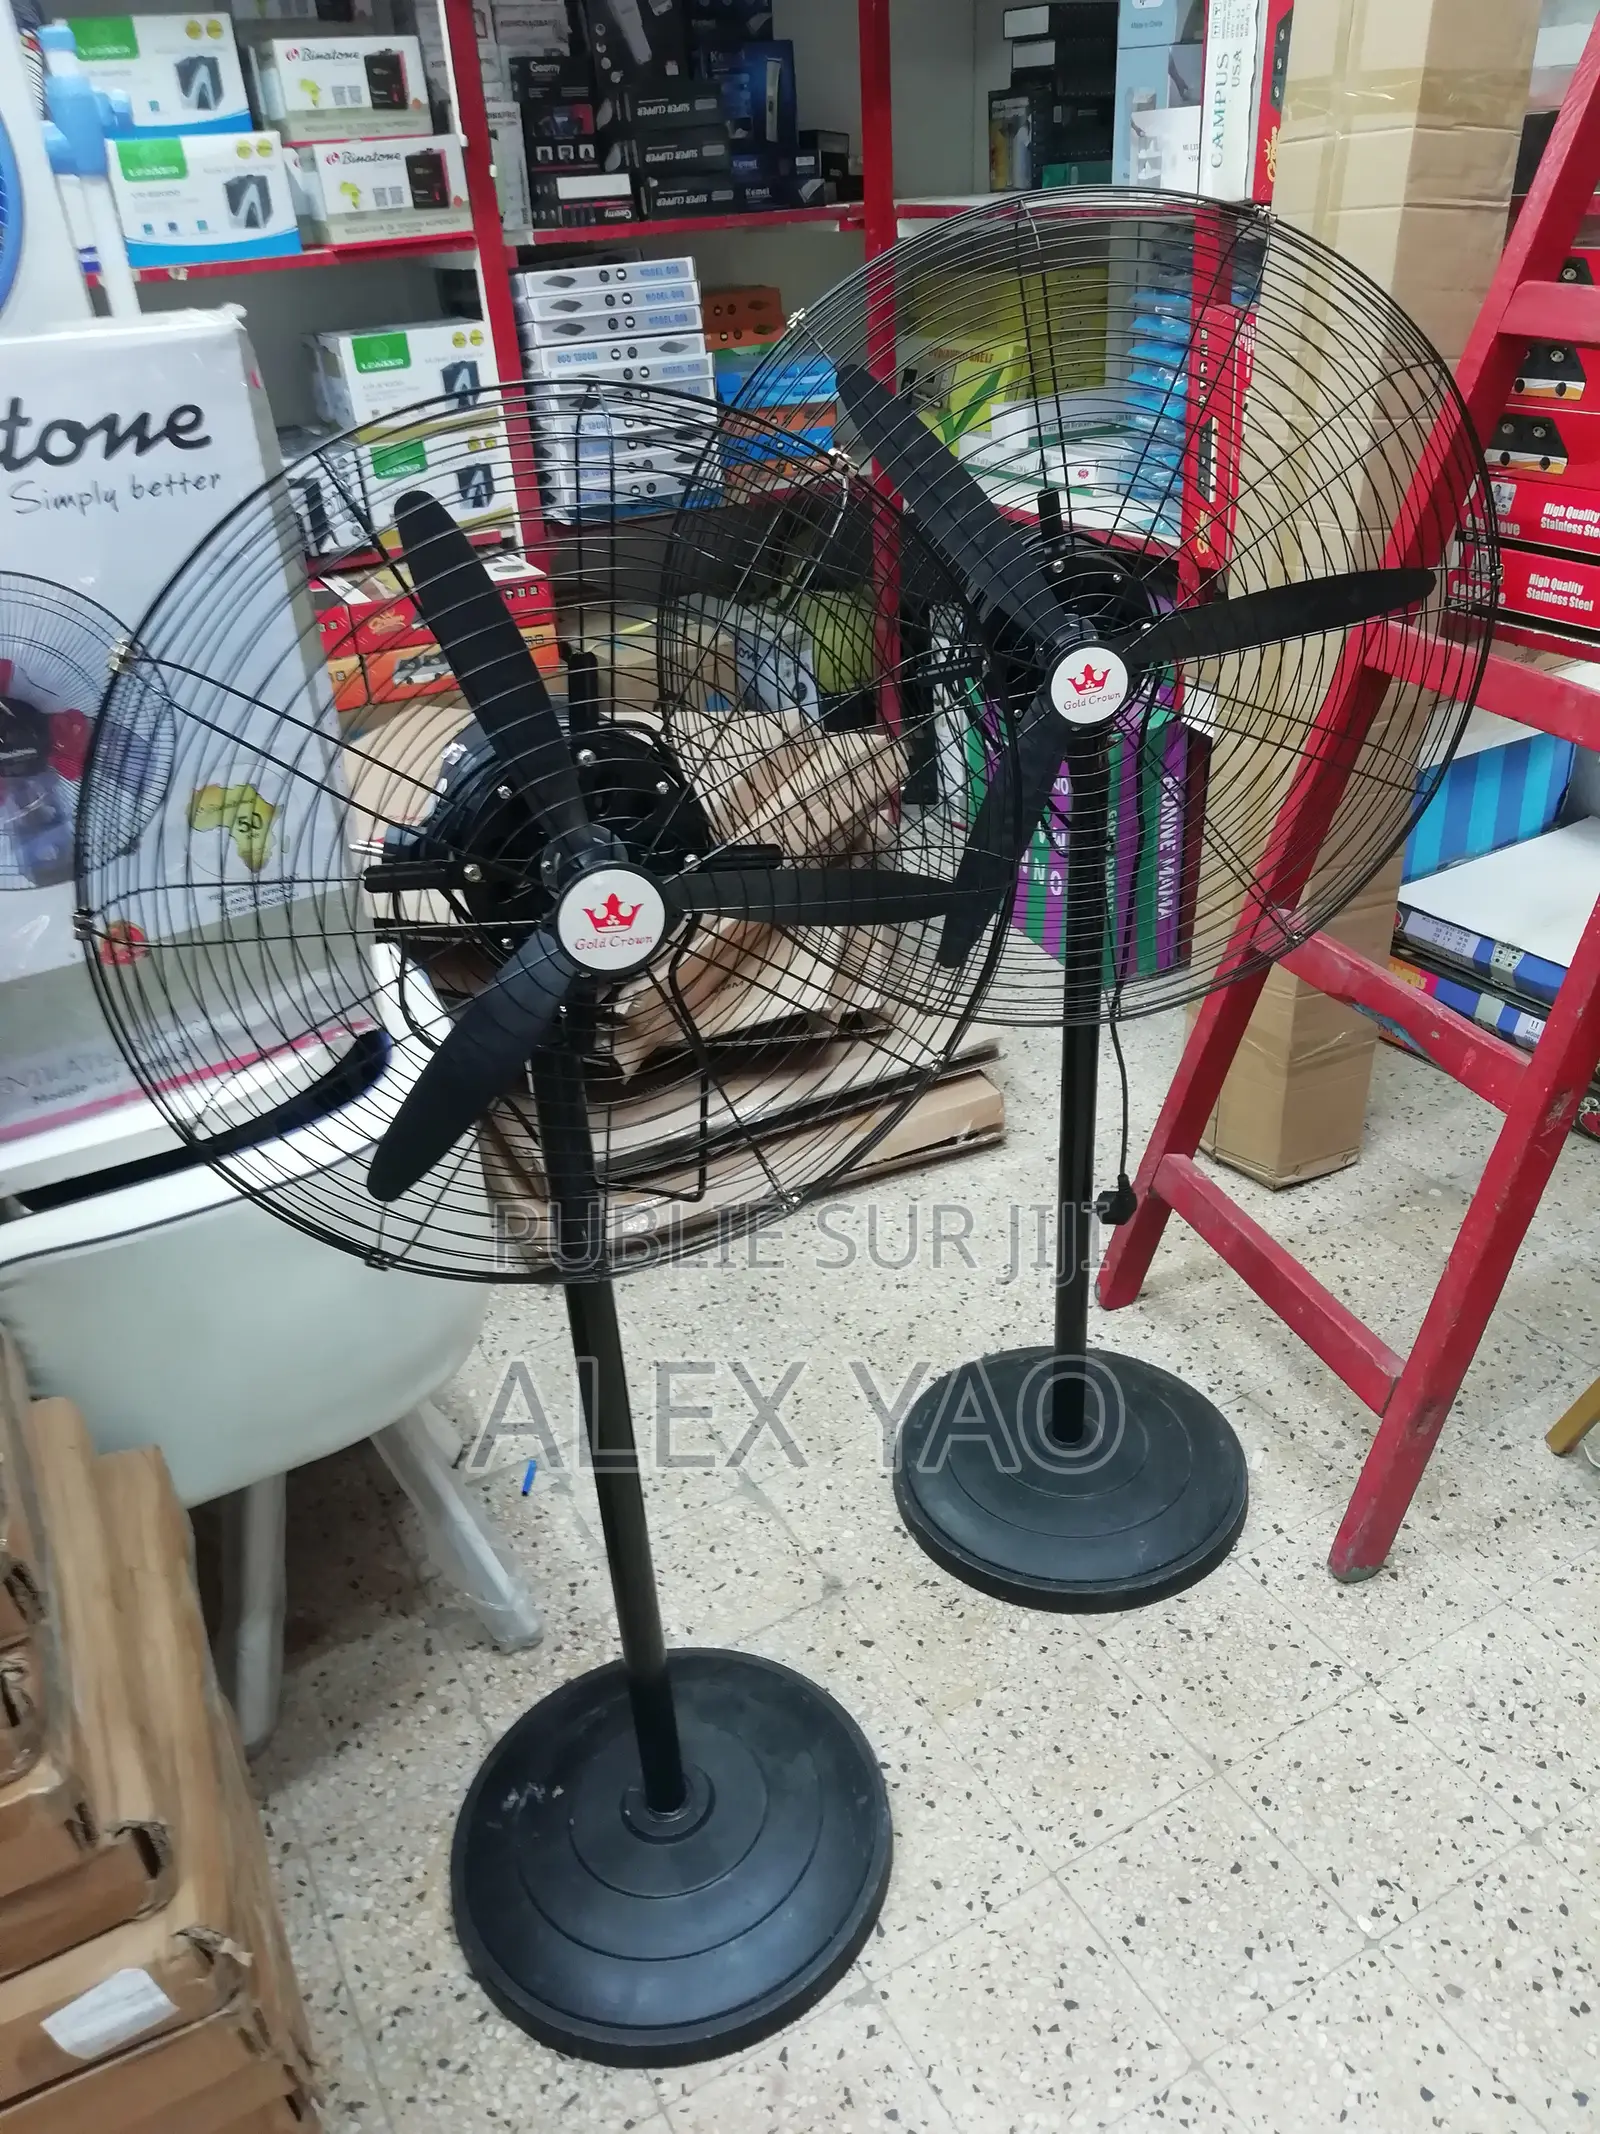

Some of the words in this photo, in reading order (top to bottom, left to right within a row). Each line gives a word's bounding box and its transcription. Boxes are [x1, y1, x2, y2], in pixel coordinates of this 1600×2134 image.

[301, 47, 361, 62] Binatone
[1231, 50, 1242, 88] USA
[637, 105, 666, 117] CLIPPER
[667, 103, 690, 114] SUPER
[1211, 52, 1229, 169] CAMPUS
[341, 151, 402, 165] Binatone
[645, 152, 674, 163] CLIPPER
[675, 149, 698, 160] SUPER
[656, 196, 684, 207] CLIPPER
[686, 194, 708, 205] SUPER
[0, 396, 213, 472] tone
[10, 479, 120, 515] Simply
[129, 472, 222, 500] better
[1543, 502, 1566, 517] High
[1565, 506, 1600, 523] Quality
[1540, 516, 1583, 535] Stainless
[1528, 573, 1550, 589] High
[1550, 577, 1584, 596] Quality
[1526, 586, 1569, 606] Stainless
[1568, 596, 1595, 612] Steel
[1063, 698, 1086, 711] Gold
[1088, 692, 1121, 705] Crown
[237, 811, 264, 834] 50
[574, 937, 607, 951] Gold
[609, 935, 653, 948] Crown
